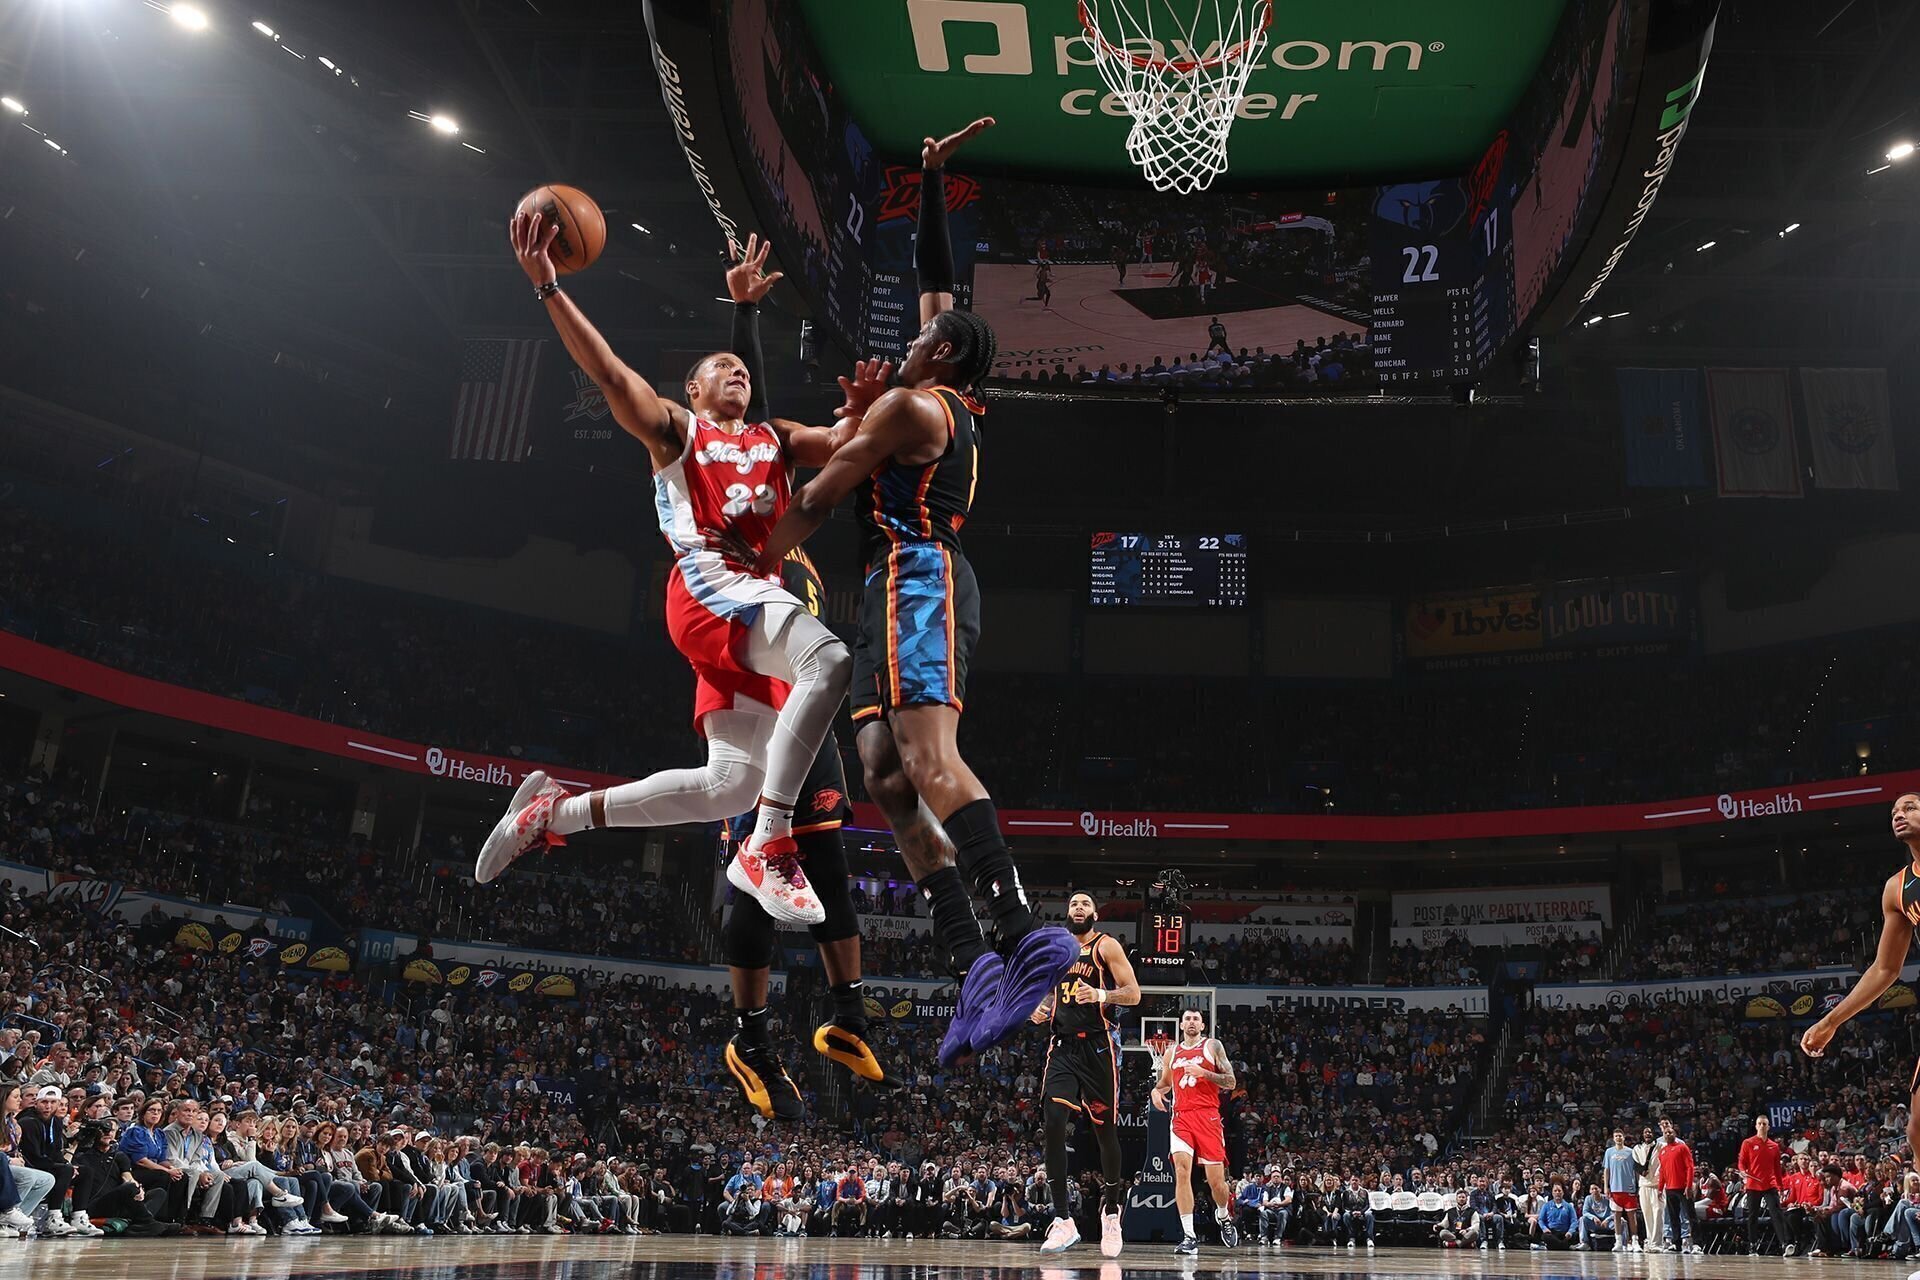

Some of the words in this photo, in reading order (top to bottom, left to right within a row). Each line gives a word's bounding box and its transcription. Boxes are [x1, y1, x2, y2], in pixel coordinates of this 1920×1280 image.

[1060, 88, 1318, 120] center
[1402, 244, 1439, 283] 22
[875, 273, 901, 284] PLAYER
[873, 286, 892, 296] DORT
[962, 284, 971, 293] FL
[1446, 288, 1460, 297] PTS
[1461, 287, 1470, 295] FL
[1374, 294, 1399, 303] PLAYER
[872, 300, 904, 311] WILLIAMS
[1373, 307, 1395, 316] WELLS
[870, 312, 901, 323] WIGGINS
[1373, 320, 1405, 329] KENNARD
[869, 326, 900, 337] WALLACE
[1374, 333, 1392, 342] BANE
[868, 339, 901, 350] WILLIAMS
[998, 345, 1104, 357] aycom
[995, 356, 1078, 368] enter
[1374, 359, 1407, 368] KONCHAR
[1379, 372, 1388, 381] TO
[1402, 372, 1410, 380] TF
[1453, 367, 1469, 376] 3:13
[574, 430, 590, 439] EST.
[592, 430, 612, 440] 2008
[721, 483, 777, 518] 22
[1121, 536, 1138, 549] 17
[1198, 537, 1220, 550] 22
[1157, 540, 1181, 549] 3:13
[806, 578, 820, 617] 5
[1622, 591, 1679, 628] CITY
[1425, 657, 1469, 671] BRING
[1474, 655, 1501, 667] THE
[1506, 651, 1574, 665] THUNDER
[1597, 645, 1629, 658] EXIT
[1633, 643, 1670, 655] NOW
[448, 760, 513, 786] Health
[1740, 792, 1802, 818] Health
[1101, 818, 1157, 837] Health
[1414, 906, 1442, 920] POST
[1461, 904, 1484, 919] OAK
[1489, 902, 1531, 918] PARTY
[1535, 900, 1595, 917] TERRACE
[864, 918, 882, 929] POST
[895, 919, 911, 930] OAK
[1153, 915, 1183, 929] 3:13
[1243, 927, 1262, 937] POST
[1274, 928, 1290, 937] OAK
[1422, 929, 1441, 939] POST
[1526, 926, 1545, 936] POST
[1557, 925, 1574, 935] OAK
[1156, 929, 1181, 953] 18
[281, 947, 305, 960] BUENO
[363, 940, 392, 959] 109
[1153, 957, 1185, 965] TISSOT
[1060, 980, 1078, 1004] 34
[1461, 996, 1487, 1011] 111
[1791, 997, 1812, 1012] BUENO
[915, 1005, 935, 1017] THE
[936, 1006, 956, 1018] OFF
[1143, 1172, 1173, 1183] Health
